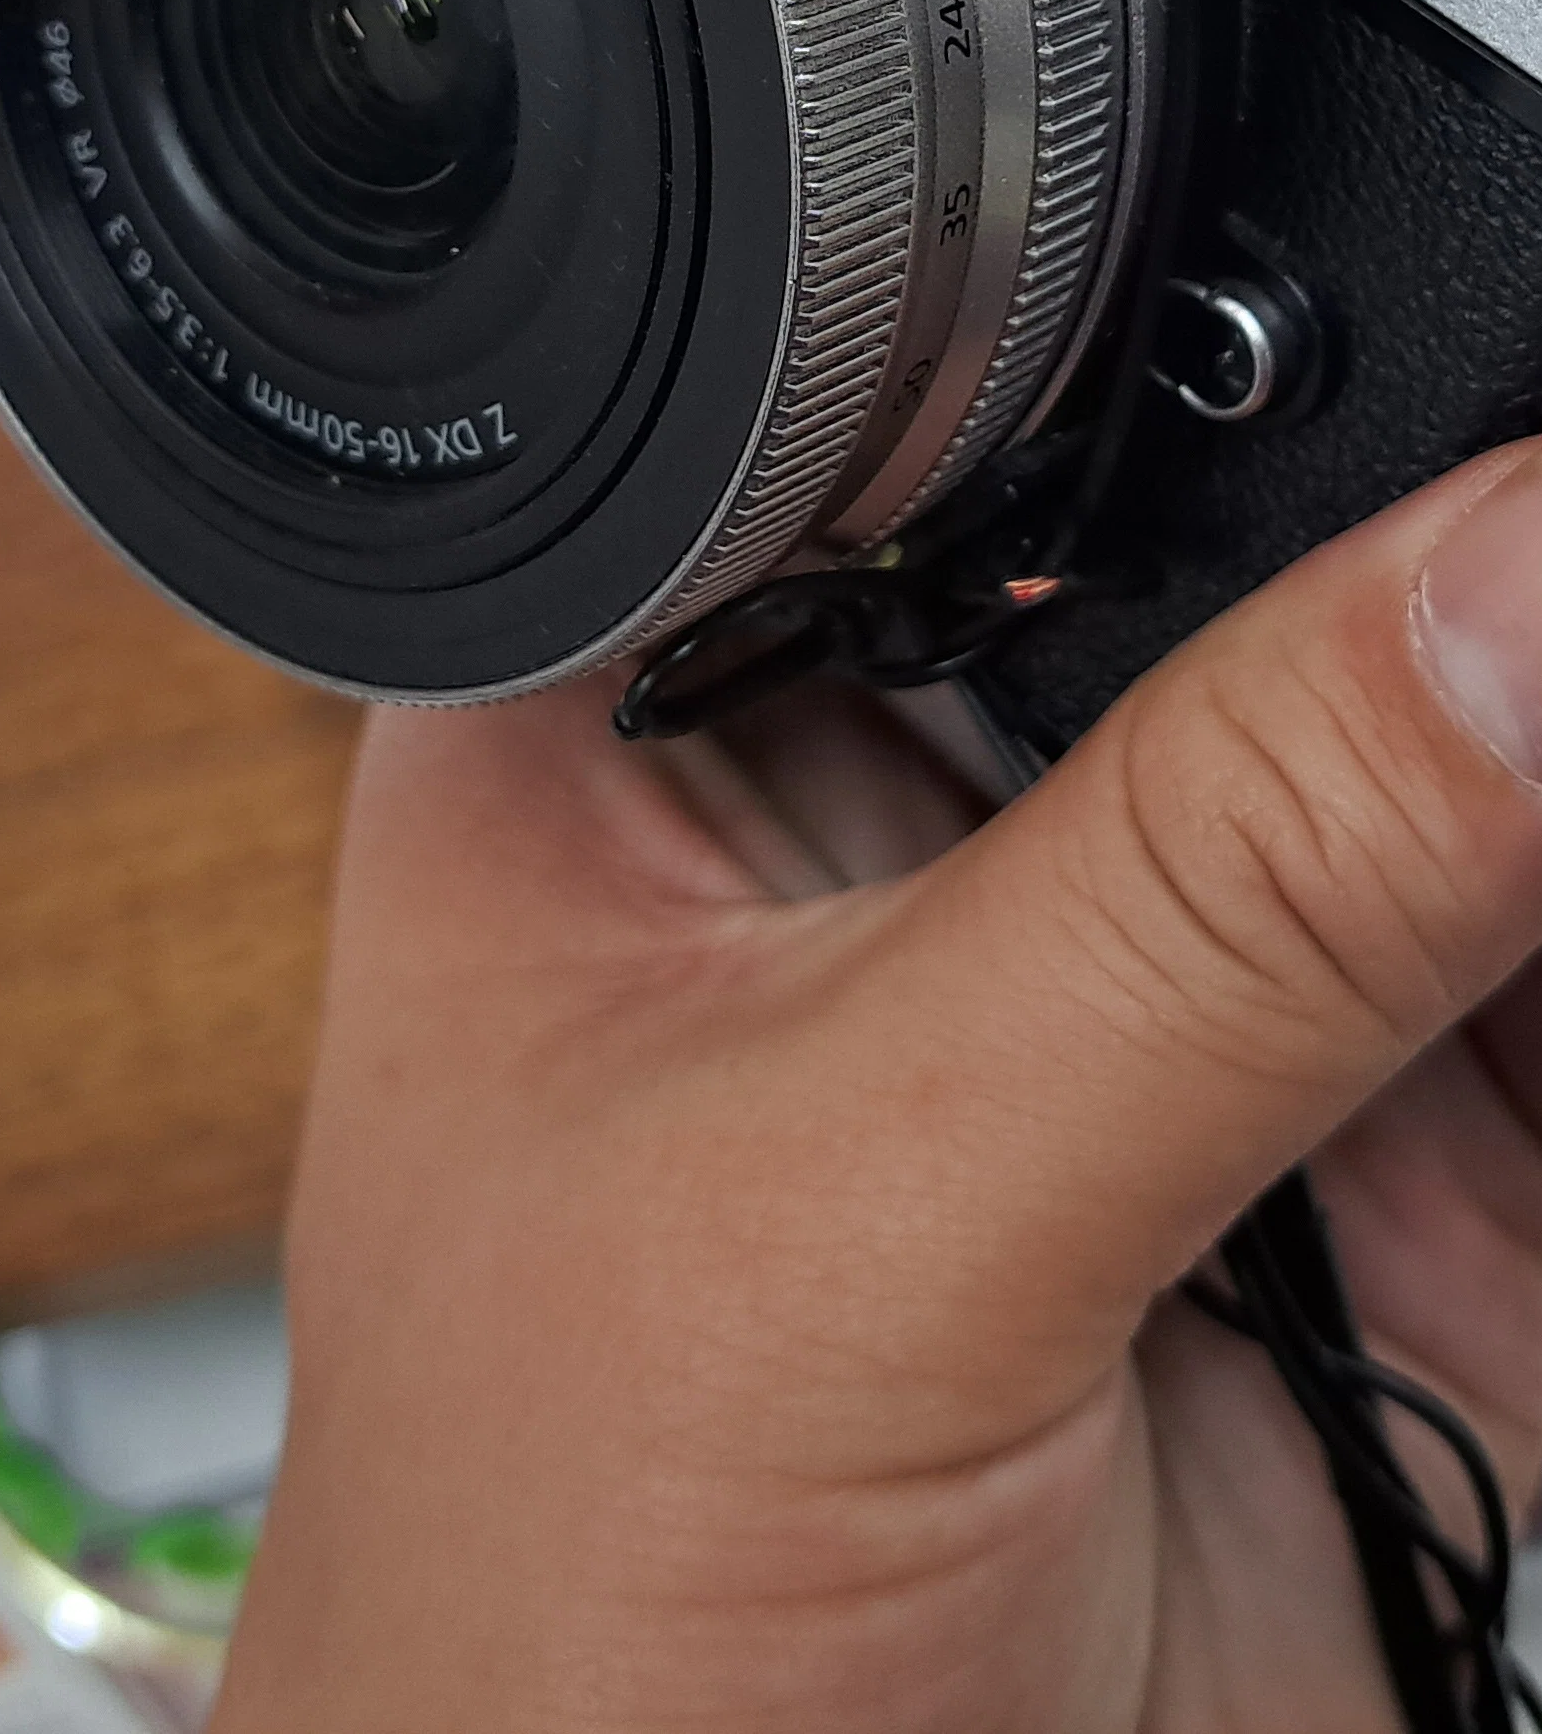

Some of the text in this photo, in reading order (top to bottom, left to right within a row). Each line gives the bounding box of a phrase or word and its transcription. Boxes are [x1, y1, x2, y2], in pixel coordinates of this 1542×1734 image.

[70, 128, 108, 200] VR
[939, 183, 970, 247] 35
[243, 370, 422, 466] 16-50mm
[423, 417, 484, 465] DX
[481, 401, 519, 451] Z
